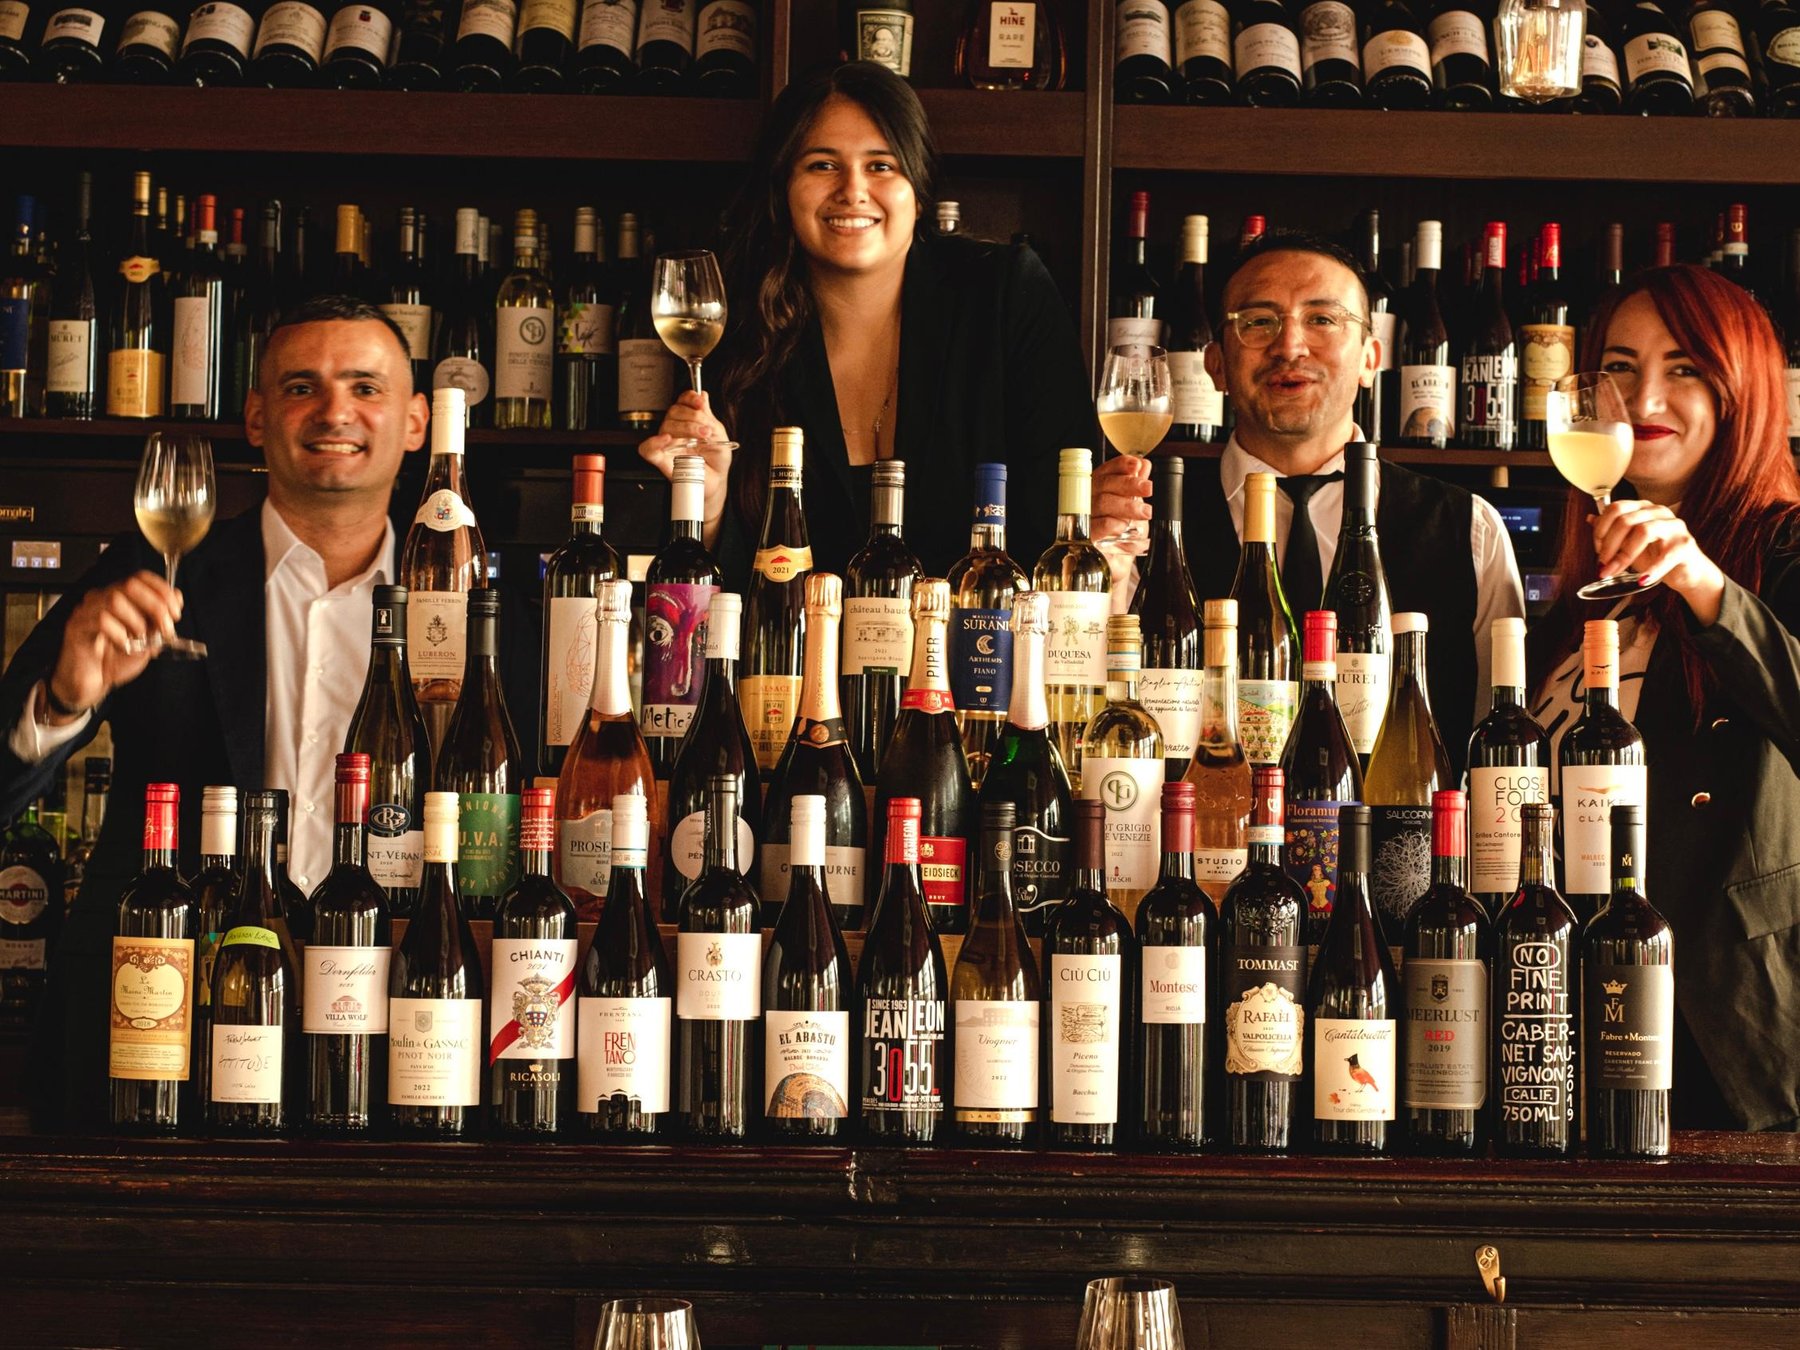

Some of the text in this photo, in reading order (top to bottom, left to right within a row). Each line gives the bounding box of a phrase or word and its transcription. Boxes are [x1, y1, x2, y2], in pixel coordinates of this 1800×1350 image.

[1000, 16, 1024, 26] HINE
[772, 566, 789, 574] 2021
[850, 604, 880, 614] château
[926, 638, 940, 678] PIPER
[1048, 650, 1091, 658] DUQUESA
[1494, 776, 1540, 790] CLOS
[1496, 791, 1545, 806] FOUS
[1116, 824, 1152, 832] GRIGIO
[459, 832, 504, 846] U.V.A.
[1113, 834, 1152, 842] VENEZIE
[781, 863, 857, 876] GURNE
[924, 867, 960, 878] EIDSIECK
[1016, 861, 1060, 873] SECCO
[510, 950, 564, 963] CHIANTI
[1520, 948, 1549, 964] NO
[319, 960, 376, 980] Dornfelder
[1237, 959, 1299, 970] TOMMASI
[688, 969, 742, 981] CRASTO
[1060, 967, 1110, 981] CIÙ CIÙ
[1511, 969, 1562, 990] FINE
[872, 1000, 907, 1009] SINCE 1963
[1507, 992, 1568, 1012] PRINT
[865, 999, 944, 1039] JEAN LEON
[1424, 1030, 1455, 1041] RED
[1502, 1021, 1575, 1041] CABER-
[1600, 1031, 1623, 1040] Fabre
[604, 1032, 635, 1051] FREN
[779, 1032, 836, 1046] EL ABASTO
[604, 1050, 635, 1064] TANO
[1502, 1044, 1536, 1062] NET
[510, 1072, 560, 1081] RICASOLI
[1501, 1065, 1565, 1084] VIGNON
[1512, 1090, 1553, 1100] CALIF.
